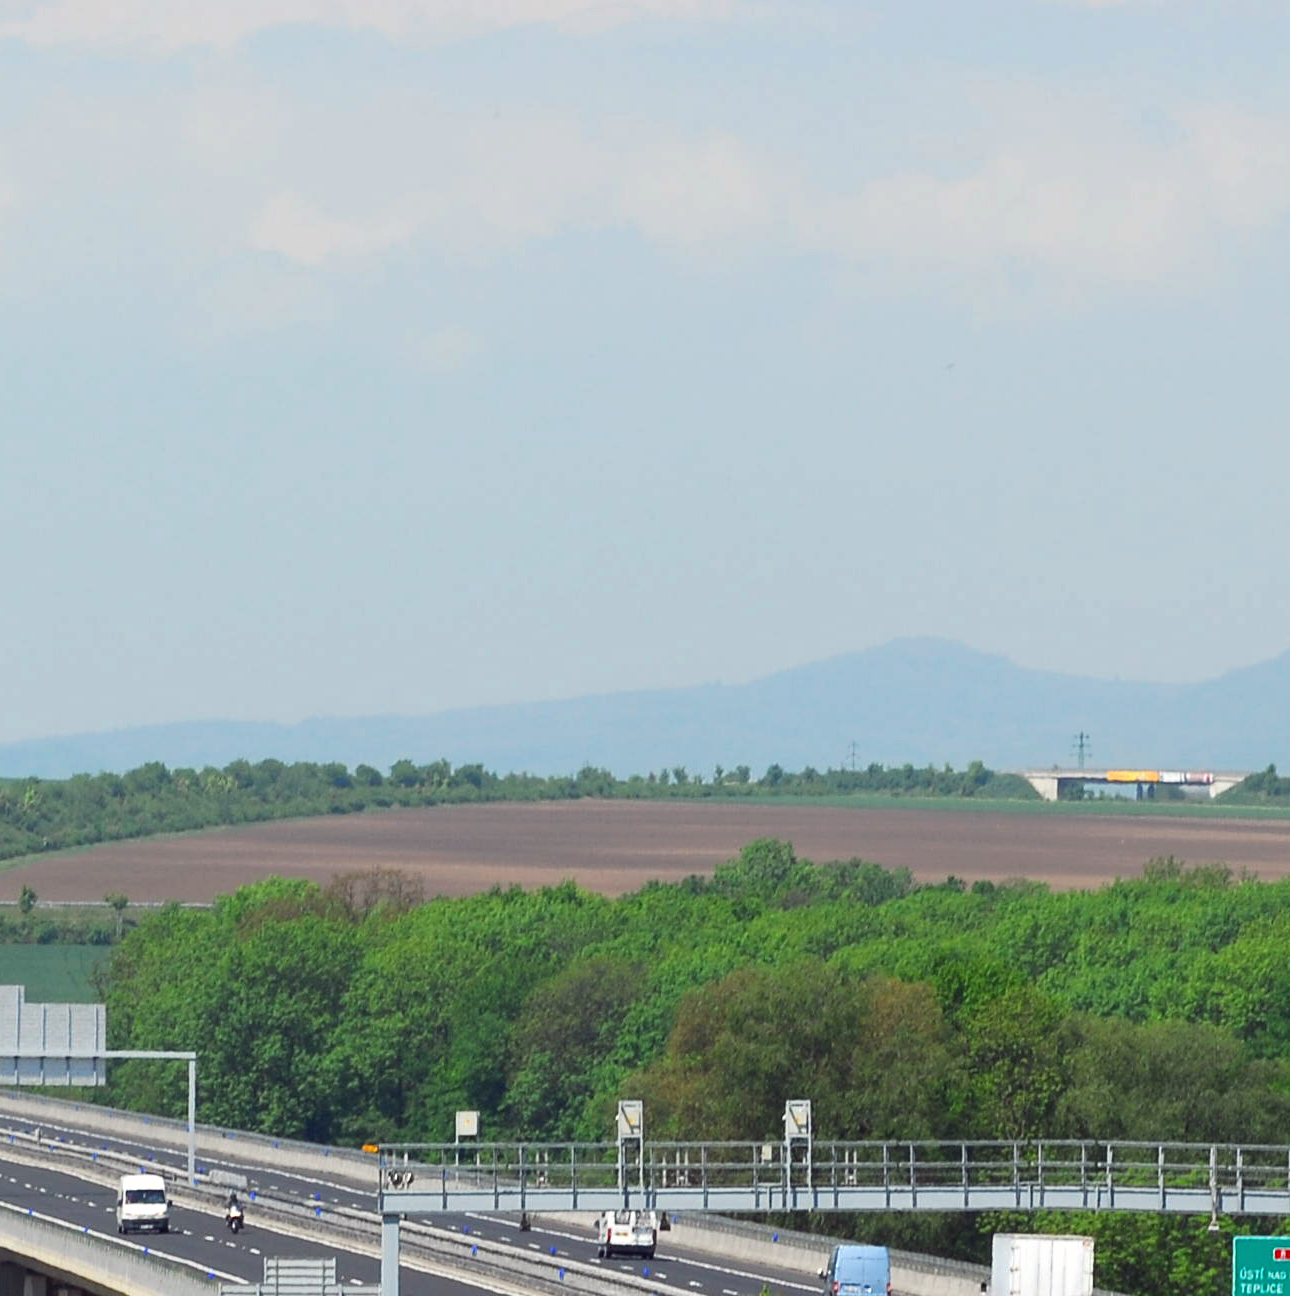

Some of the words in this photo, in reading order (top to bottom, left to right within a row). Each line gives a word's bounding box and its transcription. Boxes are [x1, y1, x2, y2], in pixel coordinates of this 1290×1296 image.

[1239, 1266, 1264, 1280] ÚSTÍ
[1268, 1271, 1287, 1280] NAD
[1240, 1283, 1284, 1294] TEPLICE
